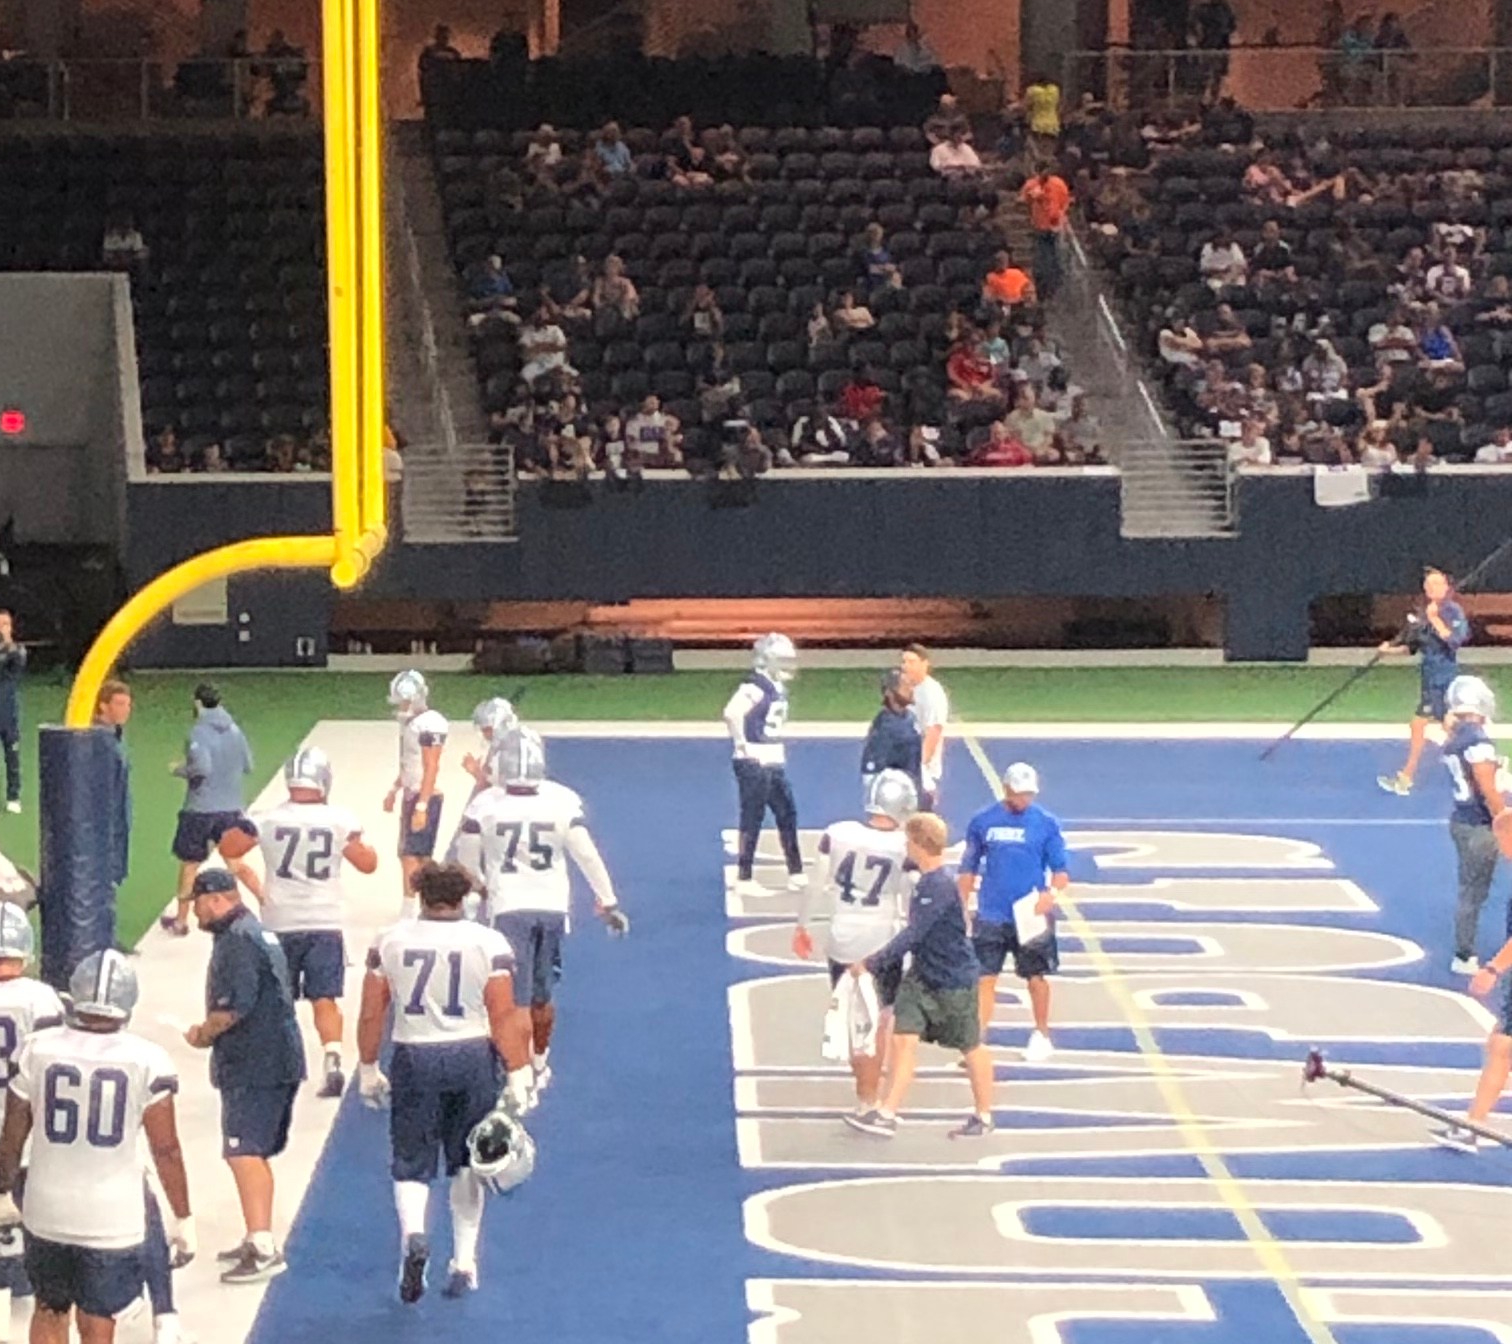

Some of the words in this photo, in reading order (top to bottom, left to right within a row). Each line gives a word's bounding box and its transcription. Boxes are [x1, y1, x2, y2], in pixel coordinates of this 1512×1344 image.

[274, 825, 334, 880] 72
[495, 821, 556, 874] 75
[834, 849, 893, 906] 47
[402, 948, 465, 1018] 71
[44, 1062, 130, 1148] 60
